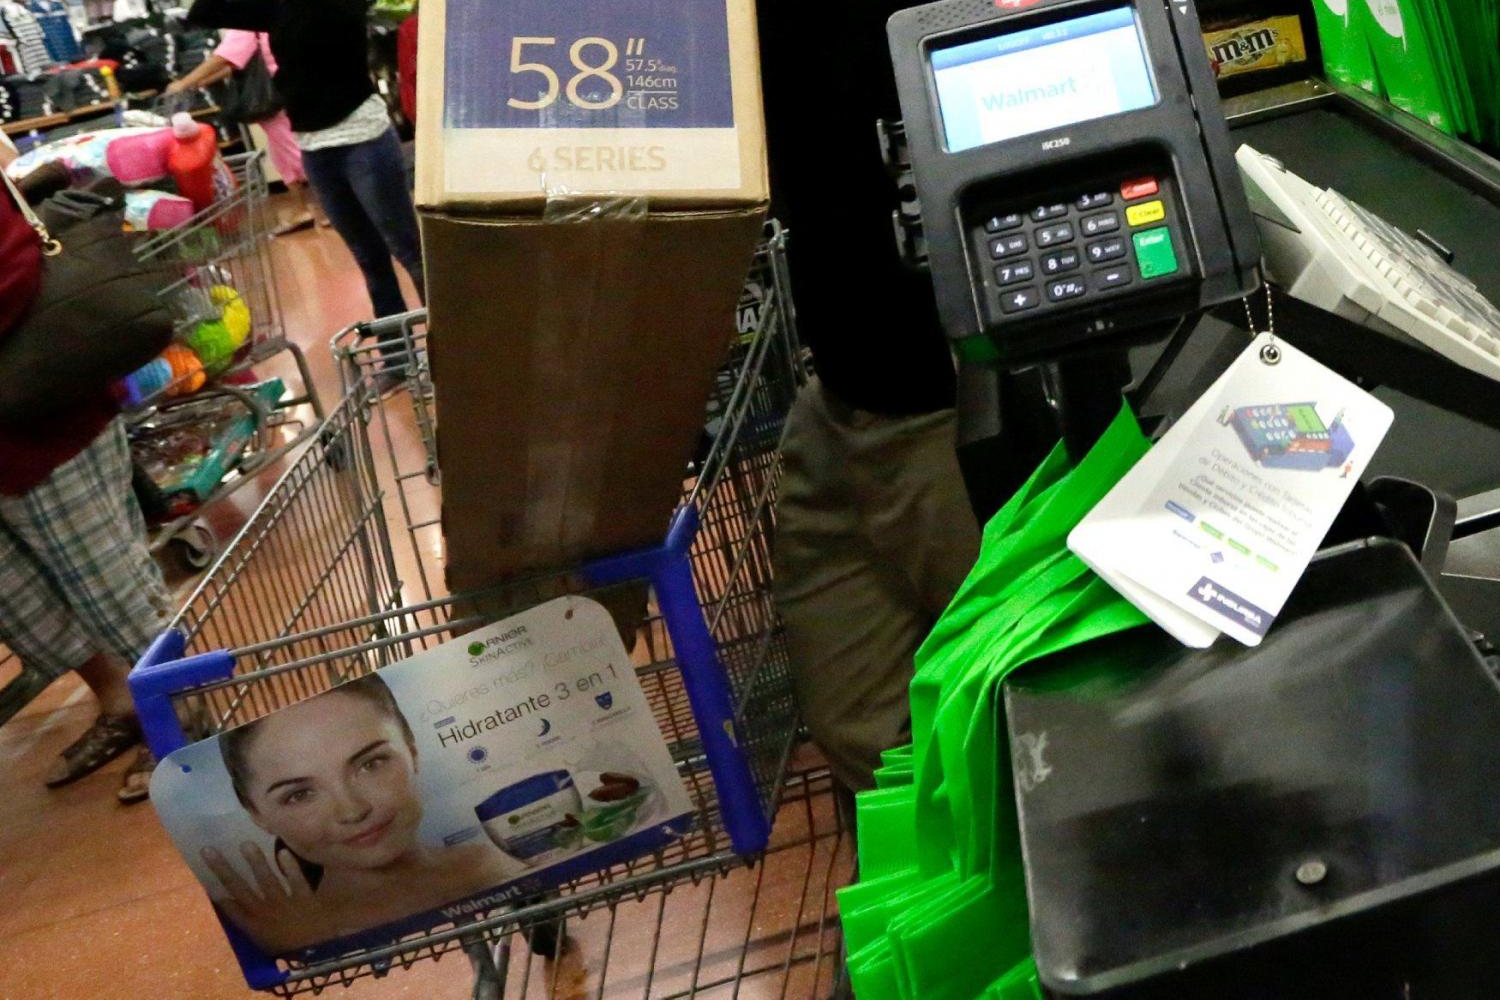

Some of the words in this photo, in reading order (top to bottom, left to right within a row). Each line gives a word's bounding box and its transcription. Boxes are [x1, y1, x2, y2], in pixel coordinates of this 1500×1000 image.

[627, 75, 677, 89] 146cm
[981, 76, 1078, 112] Walmart
[627, 96, 679, 110] CLASS
[527, 146, 545, 173] 6
[553, 145, 667, 173] SERIES
[1087, 219, 1096, 230] 6
[1042, 231, 1052, 242] 5
[1139, 233, 1165, 247] Enter
[996, 243, 1006, 255] 4
[1092, 246, 1102, 257] 9
[1048, 258, 1057, 270] 8
[1001, 269, 1011, 281] 7
[437, 693, 551, 749] Hidratante
[554, 682, 571, 701] 3
[575, 671, 603, 693] en
[606, 663, 619, 680] 1
[441, 885, 523, 919] Walmart
